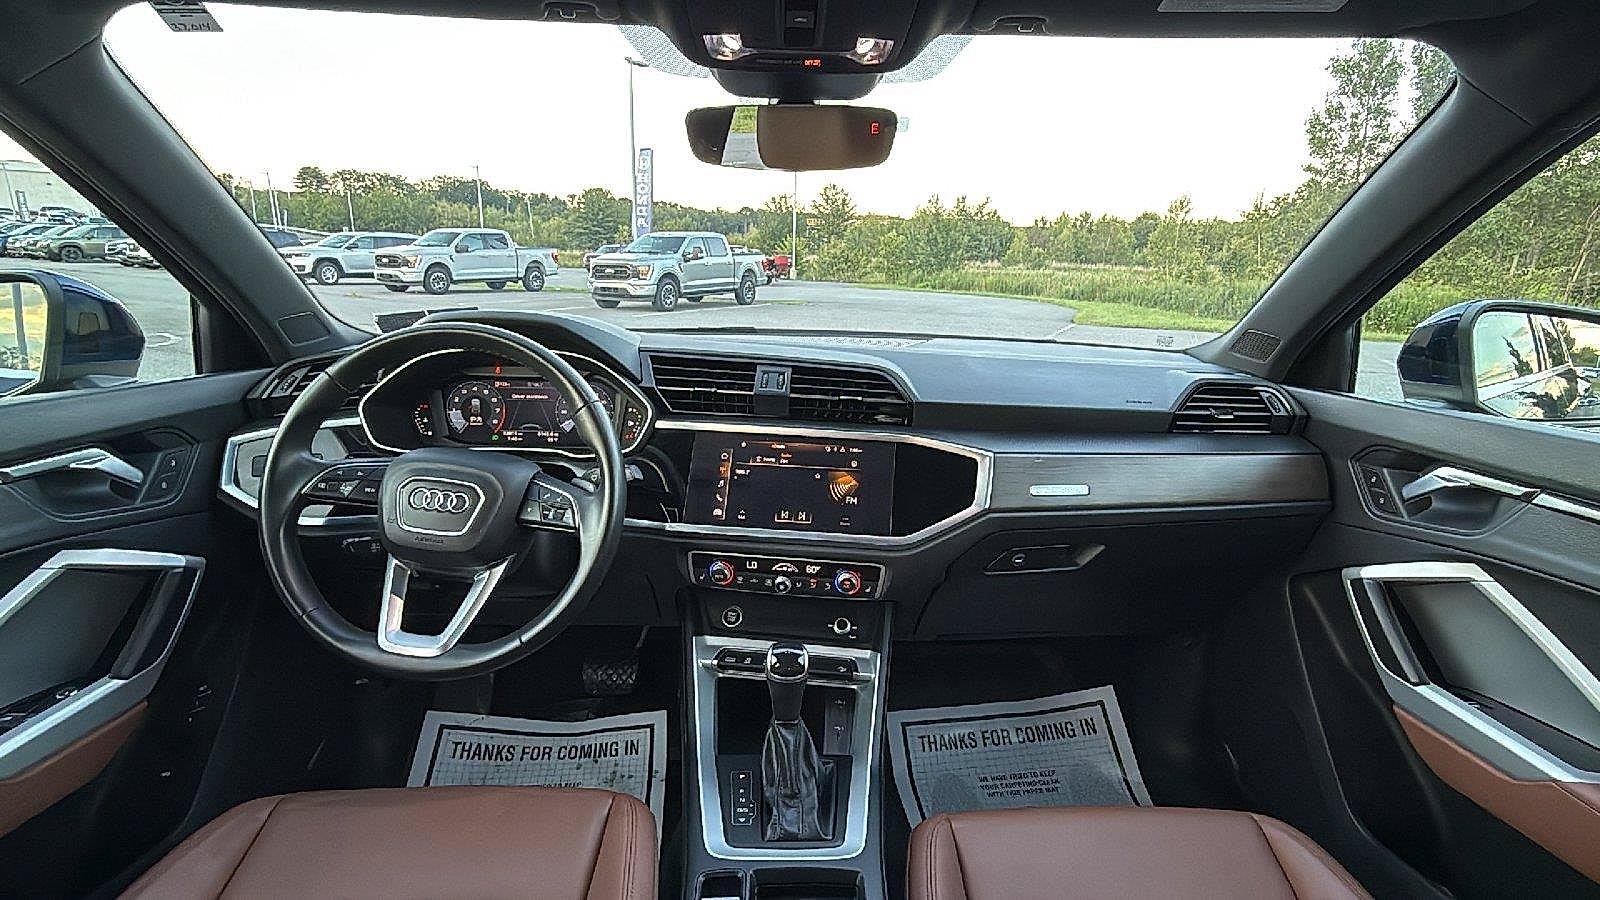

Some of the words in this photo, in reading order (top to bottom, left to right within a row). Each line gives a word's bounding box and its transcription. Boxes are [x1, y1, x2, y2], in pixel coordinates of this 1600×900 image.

[917, 731, 978, 753] THANKS
[981, 728, 1013, 748] FOR
[1015, 722, 1077, 745] COMING
[1078, 717, 1098, 737] IN
[449, 741, 515, 762] THANKS
[519, 745, 553, 762] FOR
[557, 741, 619, 760] COMING
[624, 739, 640, 756] IN
